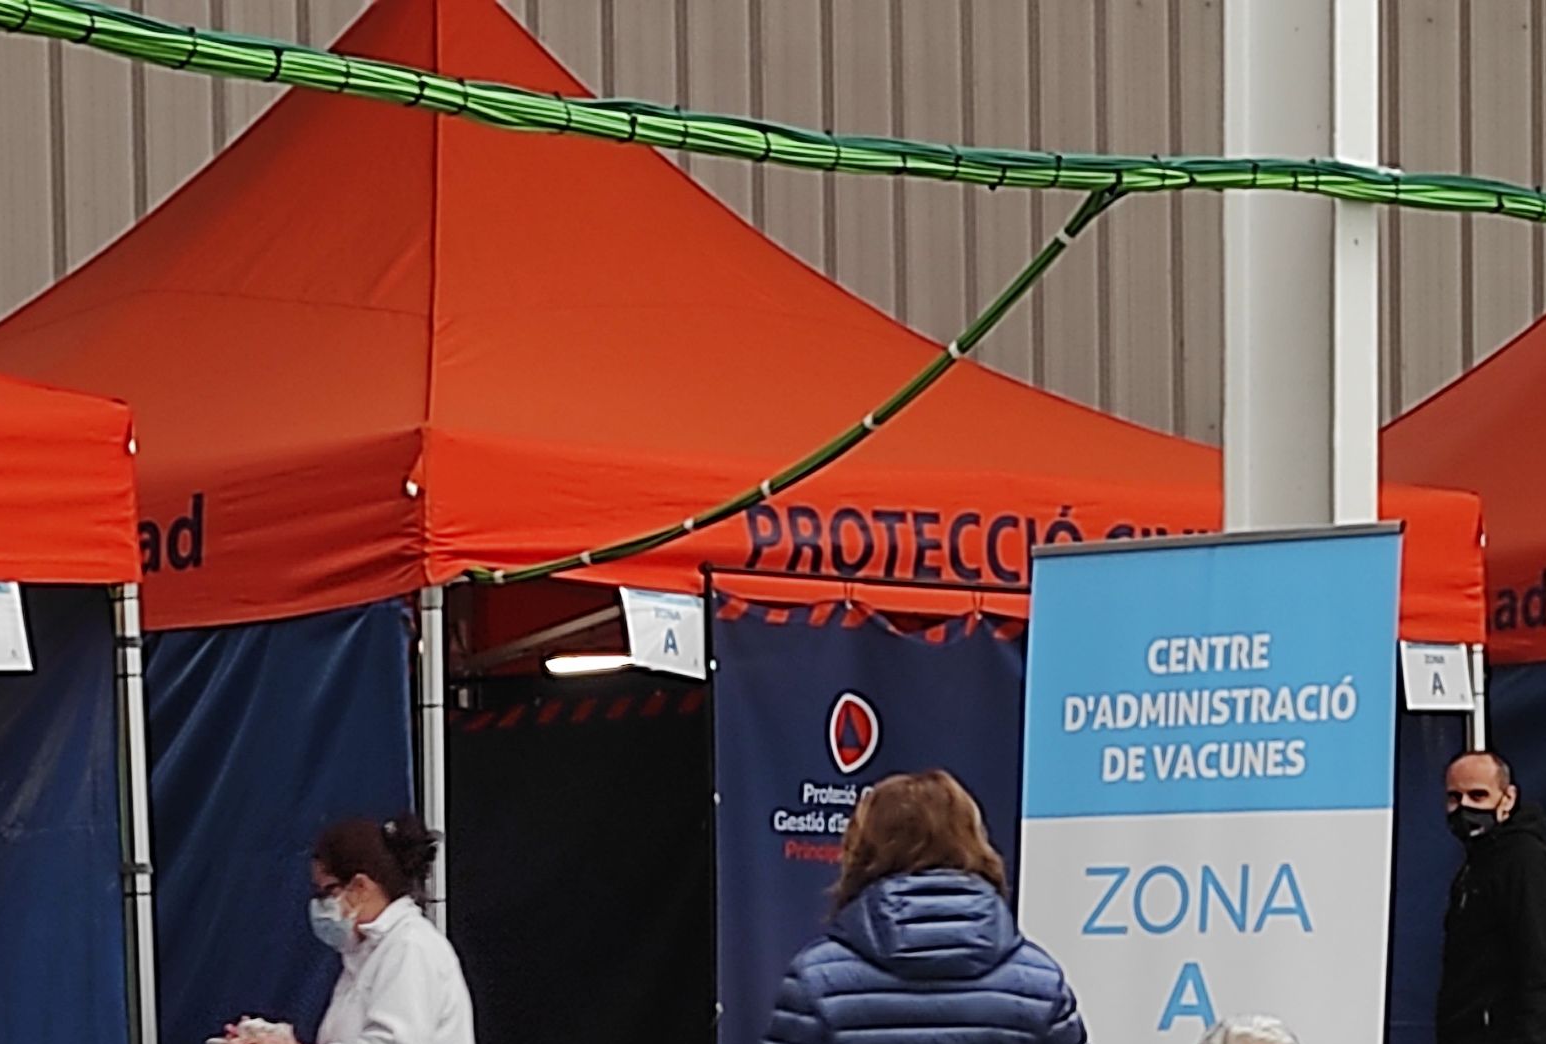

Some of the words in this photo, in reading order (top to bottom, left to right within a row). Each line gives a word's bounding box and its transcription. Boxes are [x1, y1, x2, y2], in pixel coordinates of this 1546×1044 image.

[664, 629, 679, 655] A
[1147, 633, 1270, 675] CENTRE
[1064, 675, 1357, 732] D'ADMINISTRACIÓ
[1432, 672, 1445, 696] A
[1102, 745, 1146, 782] DE
[1153, 740, 1306, 780] VACUNES
[773, 810, 824, 832] Gestió
[1081, 863, 1313, 935] ZONA
[1157, 963, 1217, 1031] A
